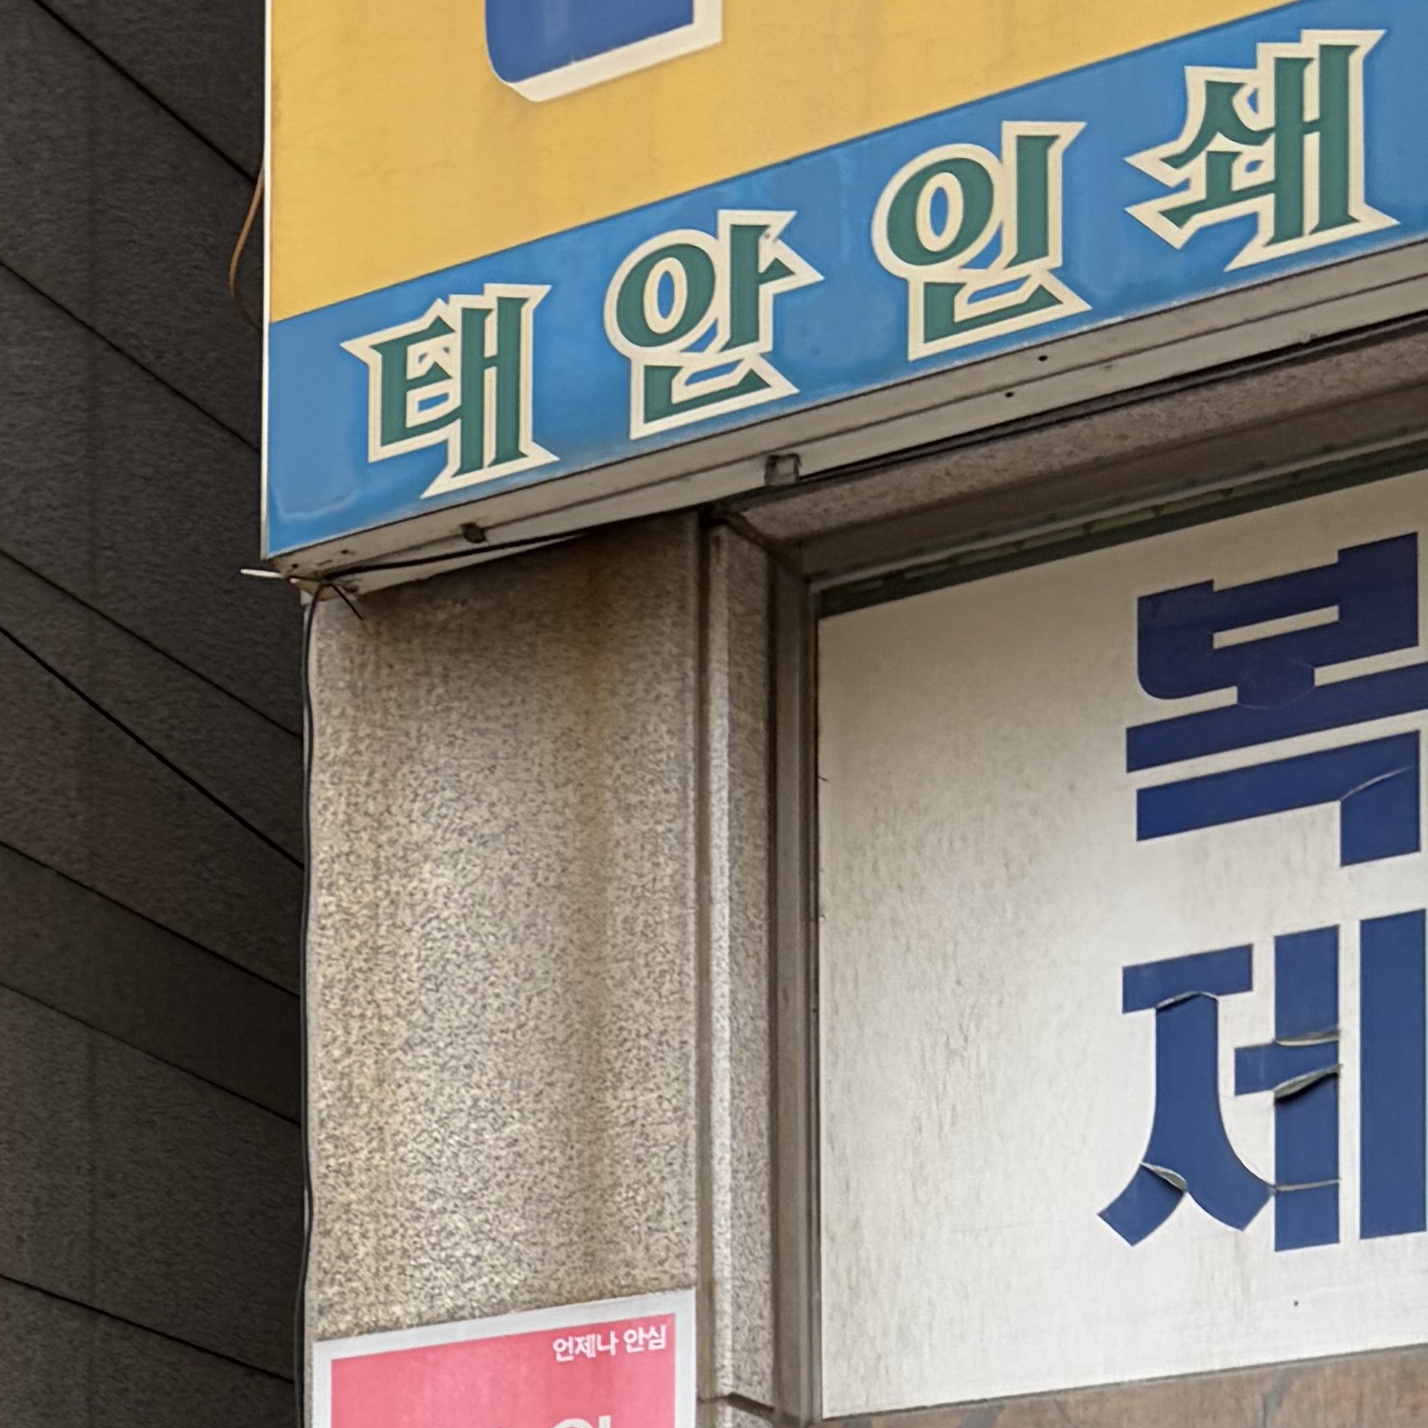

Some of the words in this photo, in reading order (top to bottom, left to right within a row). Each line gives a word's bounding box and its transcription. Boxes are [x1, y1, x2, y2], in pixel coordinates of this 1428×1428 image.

[340, 28, 1400, 499] 태안인쇄
[1097, 908, 1427, 1253] 제
[553, 1335, 619, 1362] 언제나
[625, 1324, 668, 1355] 안심
